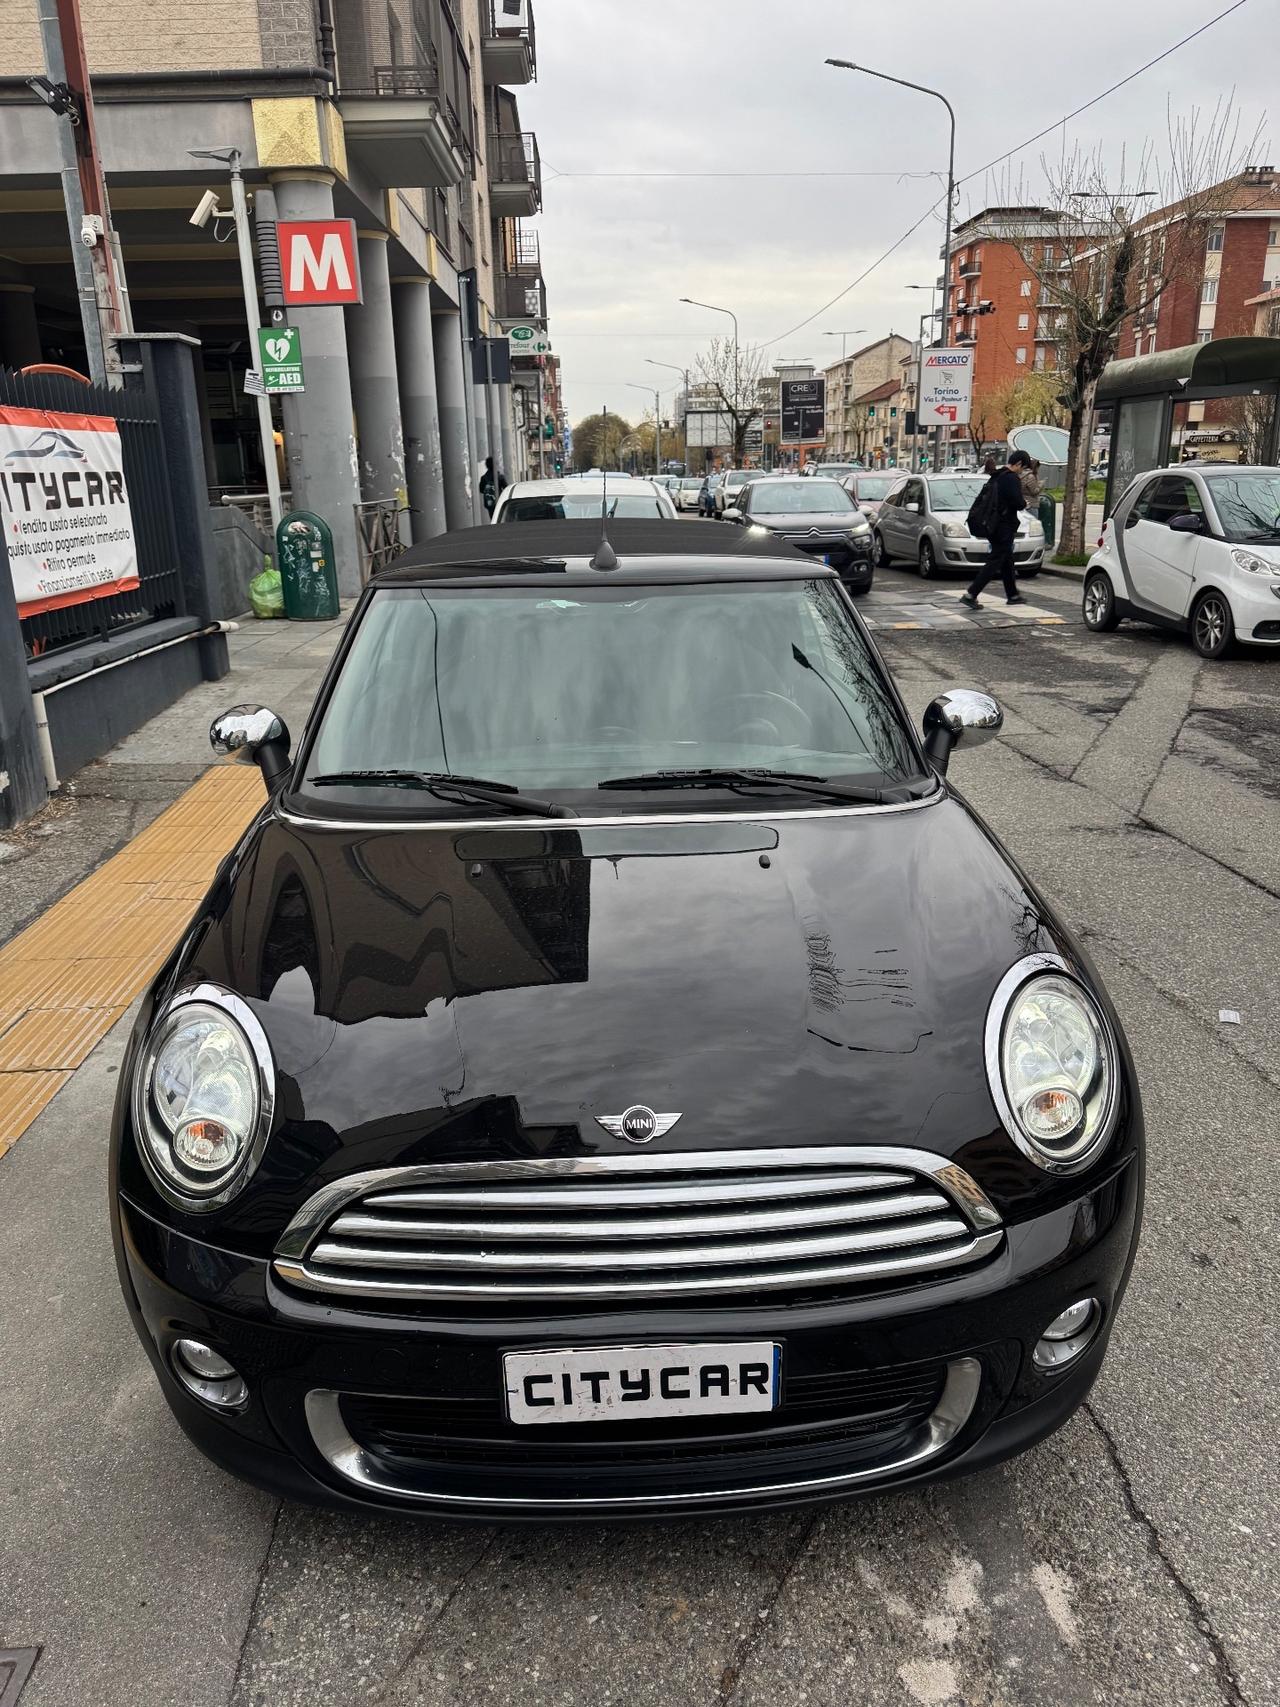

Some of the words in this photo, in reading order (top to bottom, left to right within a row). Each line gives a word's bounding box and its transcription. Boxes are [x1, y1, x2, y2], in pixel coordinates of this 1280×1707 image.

[290, 234, 352, 291] M
[279, 373, 301, 385] AED
[934, 387, 959, 395] Torino
[50, 516, 68, 532] usato
[70, 512, 107, 529] selezionato
[8, 541, 32, 560] quisto
[33, 538, 53, 554] usato
[56, 533, 95, 553] pagamento
[96, 528, 130, 544] immediato
[46, 557, 65, 572] Ritiro
[67, 552, 96, 571] permute
[40, 571, 91, 593] Finanziamenti
[92, 571, 97, 582] in
[97, 567, 114, 581] sede
[626, 1118, 653, 1130] MINI
[523, 1362, 769, 1407] CITYCAR
